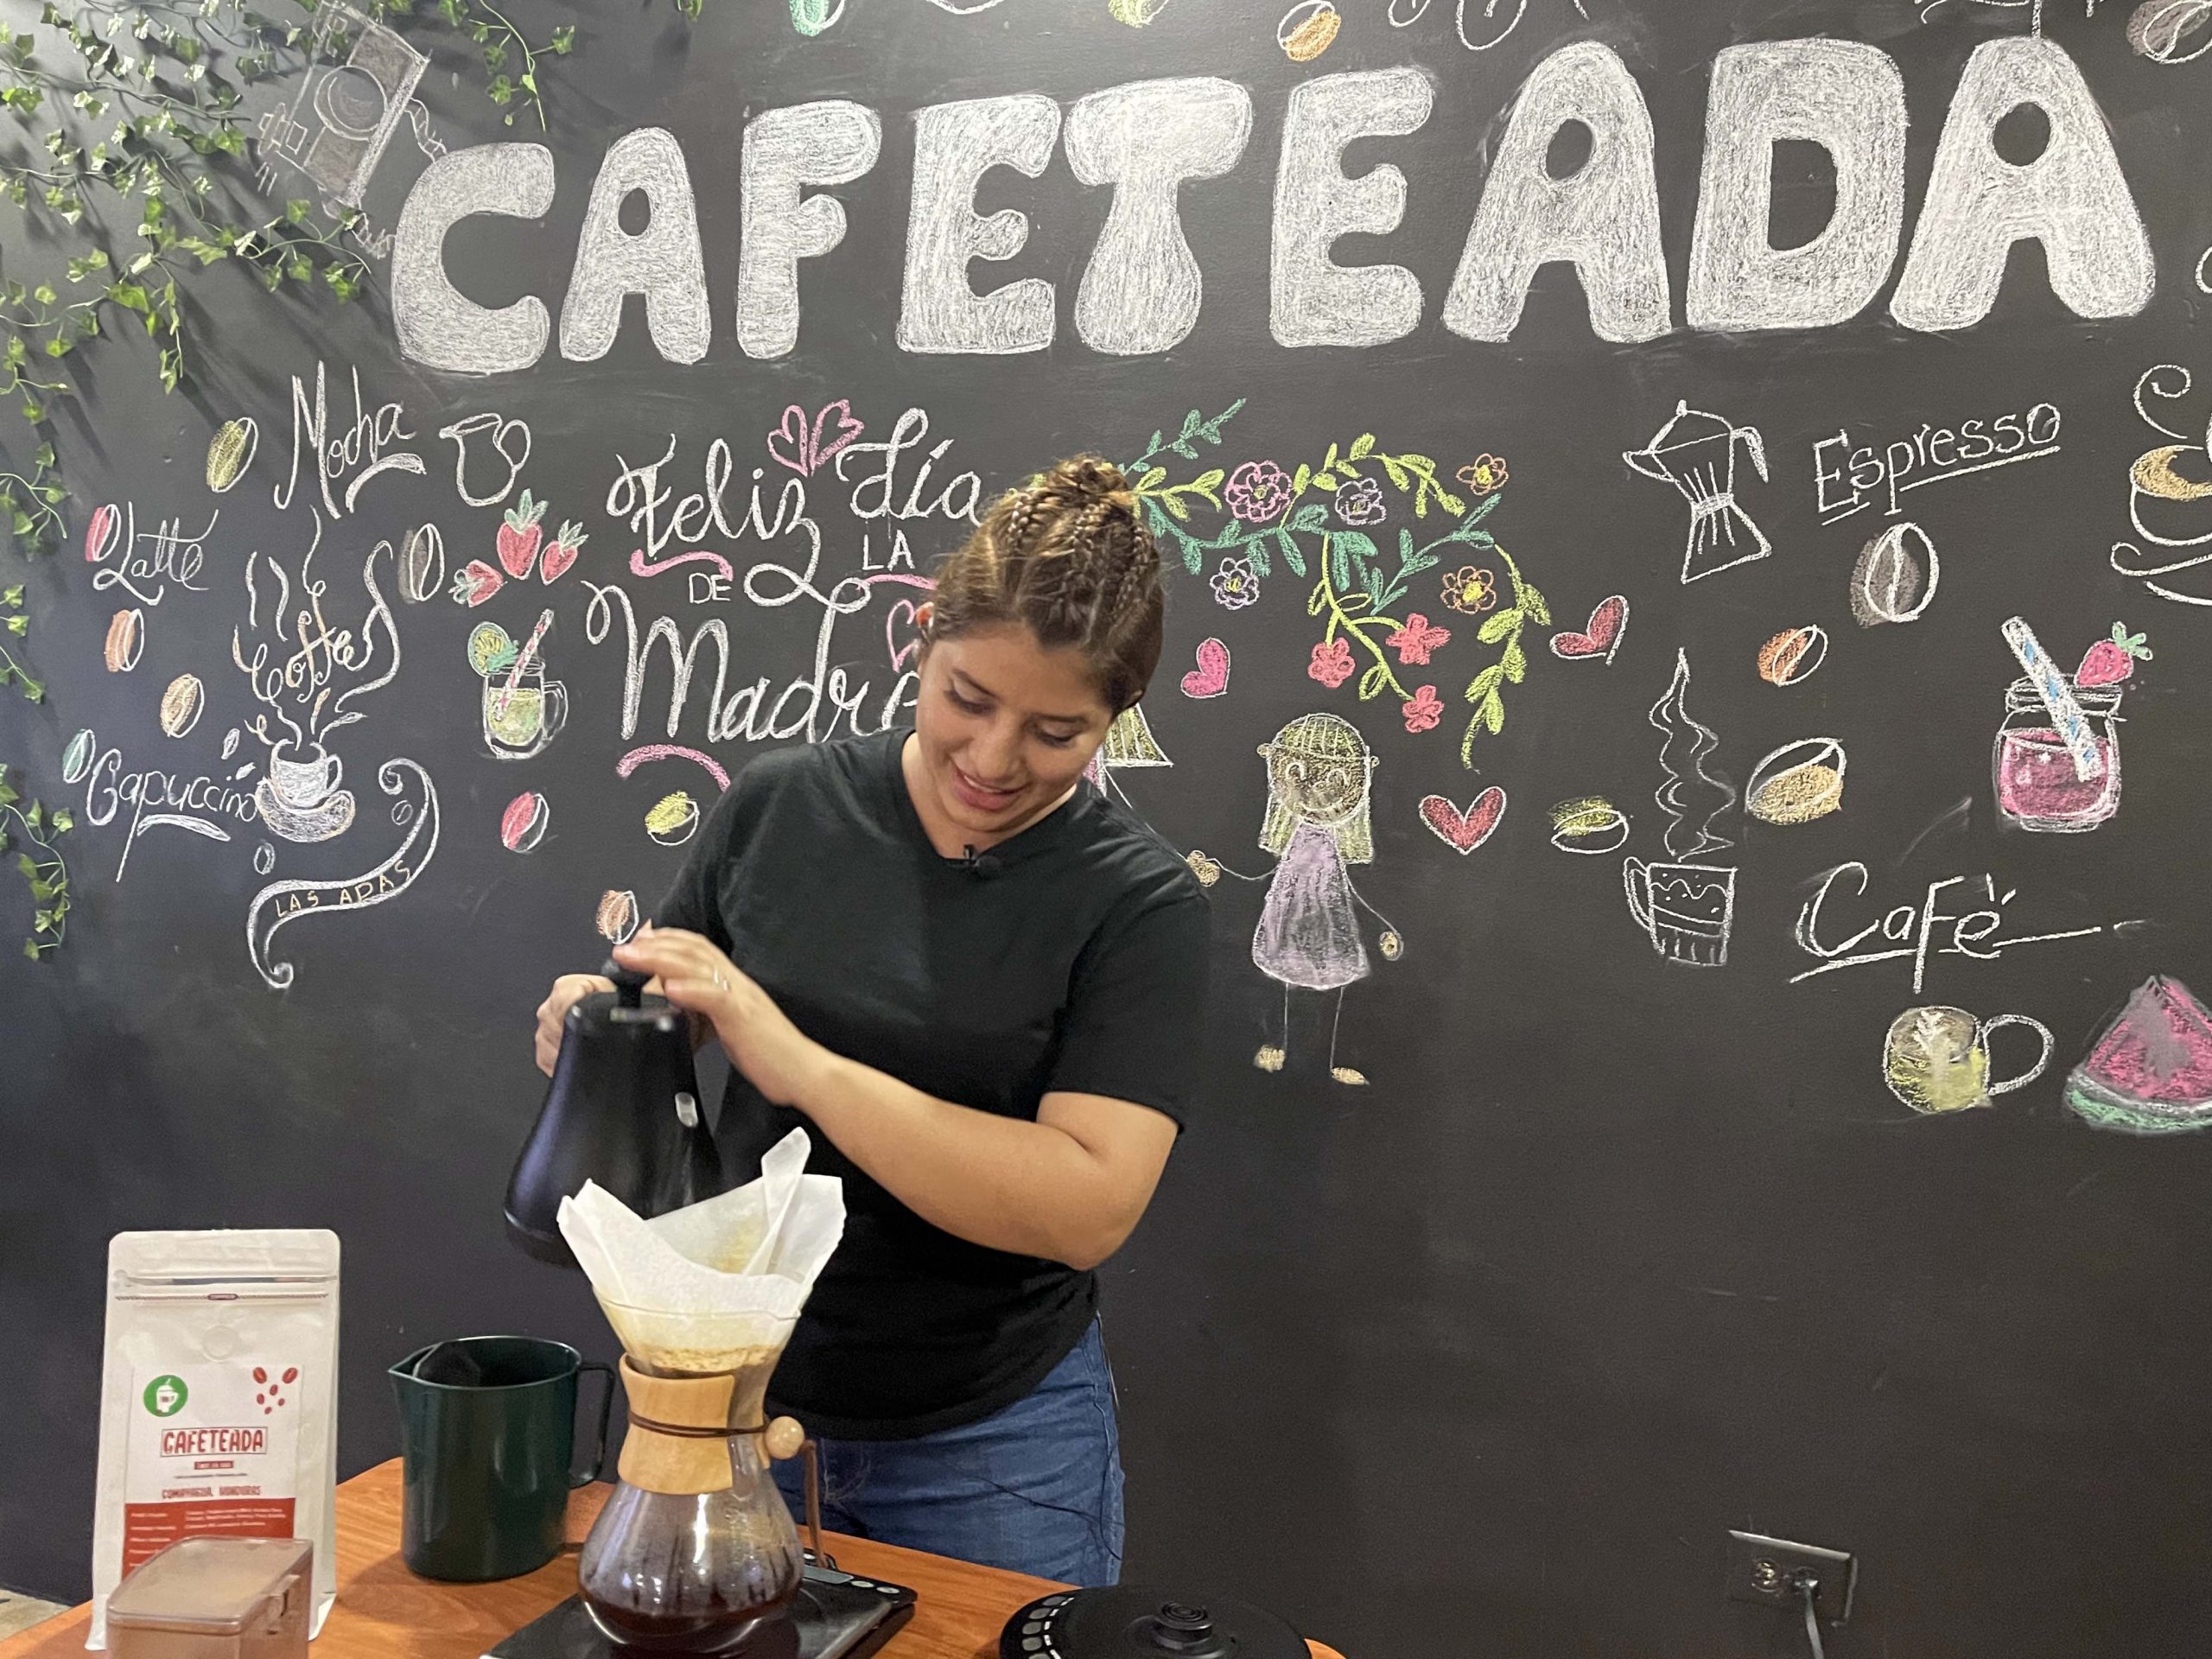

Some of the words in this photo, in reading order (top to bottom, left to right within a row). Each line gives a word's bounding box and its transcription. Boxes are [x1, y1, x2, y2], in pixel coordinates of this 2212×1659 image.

[391, 36, 2156, 375] CAFETEADA
[275, 360, 418, 518] Mocha
[1814, 403, 2062, 516] Espresso
[93, 501, 219, 605] Latte
[607, 434, 823, 607] Feliz
[689, 573, 732, 604] DE
[862, 529, 916, 571] LA
[87, 748, 258, 883] Capuccino
[276, 890, 320, 918] LAS
[162, 1429, 264, 1454] CAFETEADA
